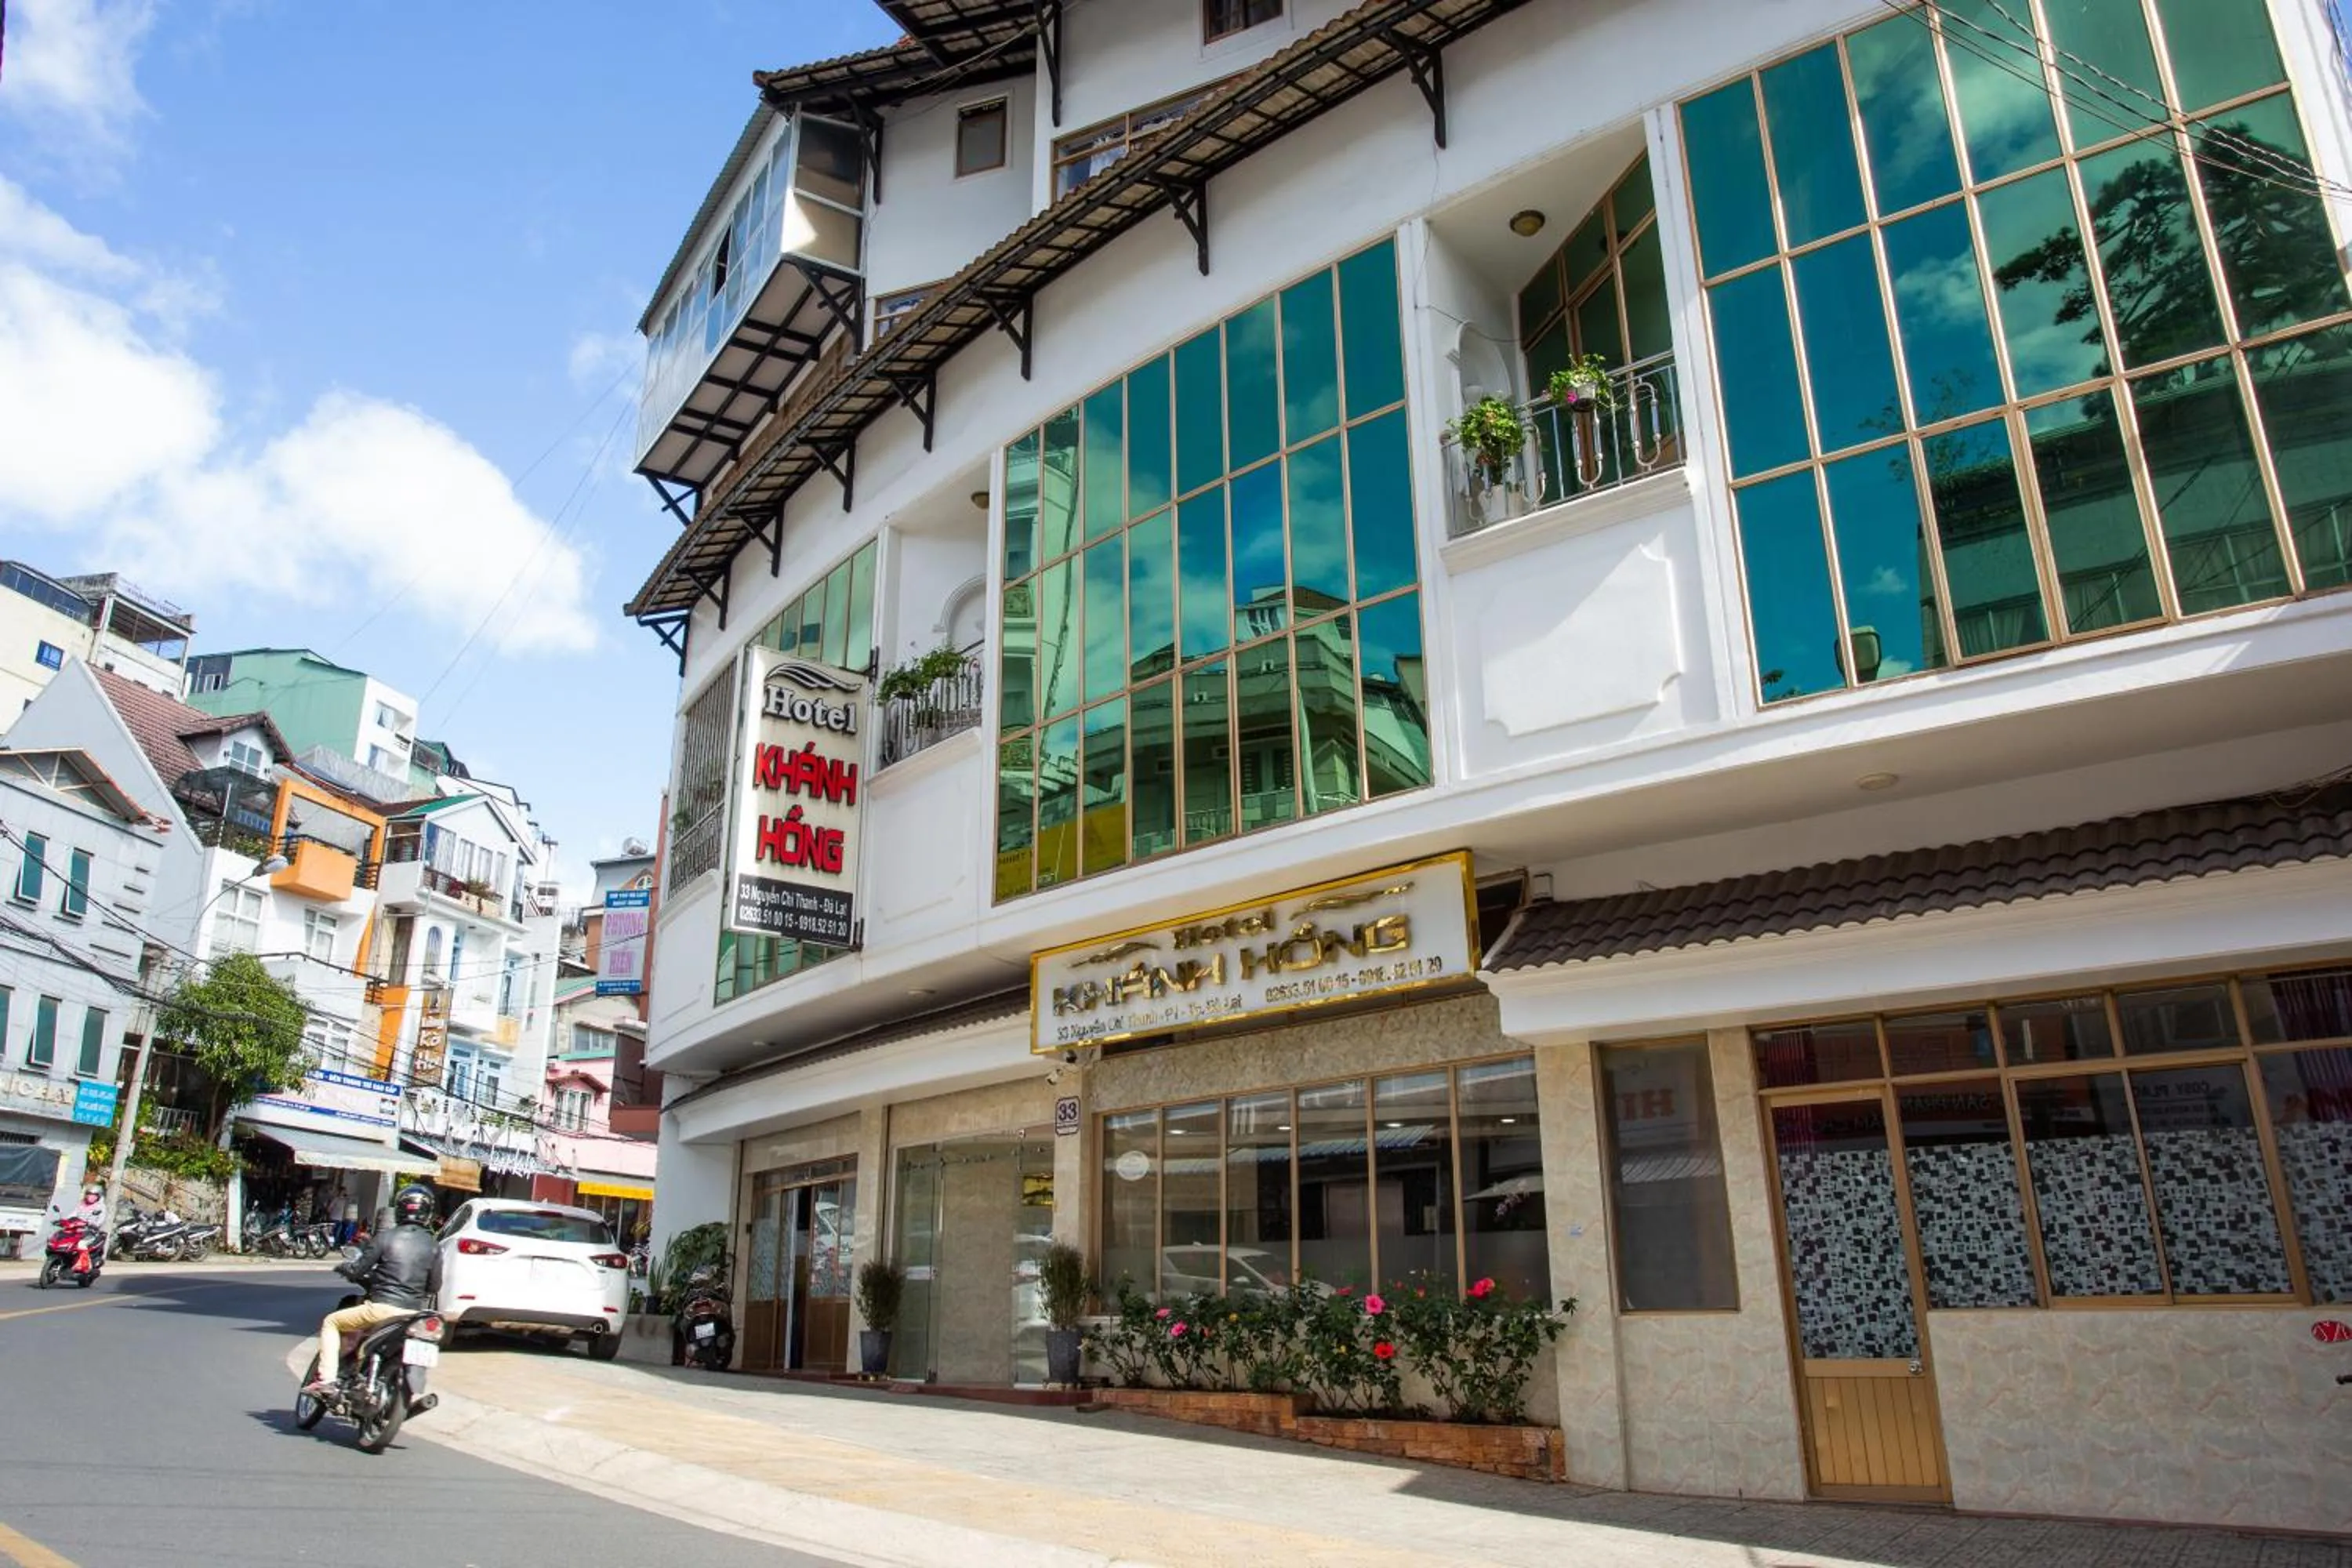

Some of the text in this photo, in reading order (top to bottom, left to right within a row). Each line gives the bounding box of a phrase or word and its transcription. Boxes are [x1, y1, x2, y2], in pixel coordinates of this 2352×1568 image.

[762, 684, 858, 735] Hotel
[753, 741, 858, 806] KHÁNH
[739, 884, 750, 899] 33
[795, 893, 818, 911] Thanh
[1174, 906, 1276, 949] Hotel
[1053, 953, 1227, 1017] KHÁNH
[1426, 956, 1443, 974] 20
[1058, 1102, 1077, 1120] 33
